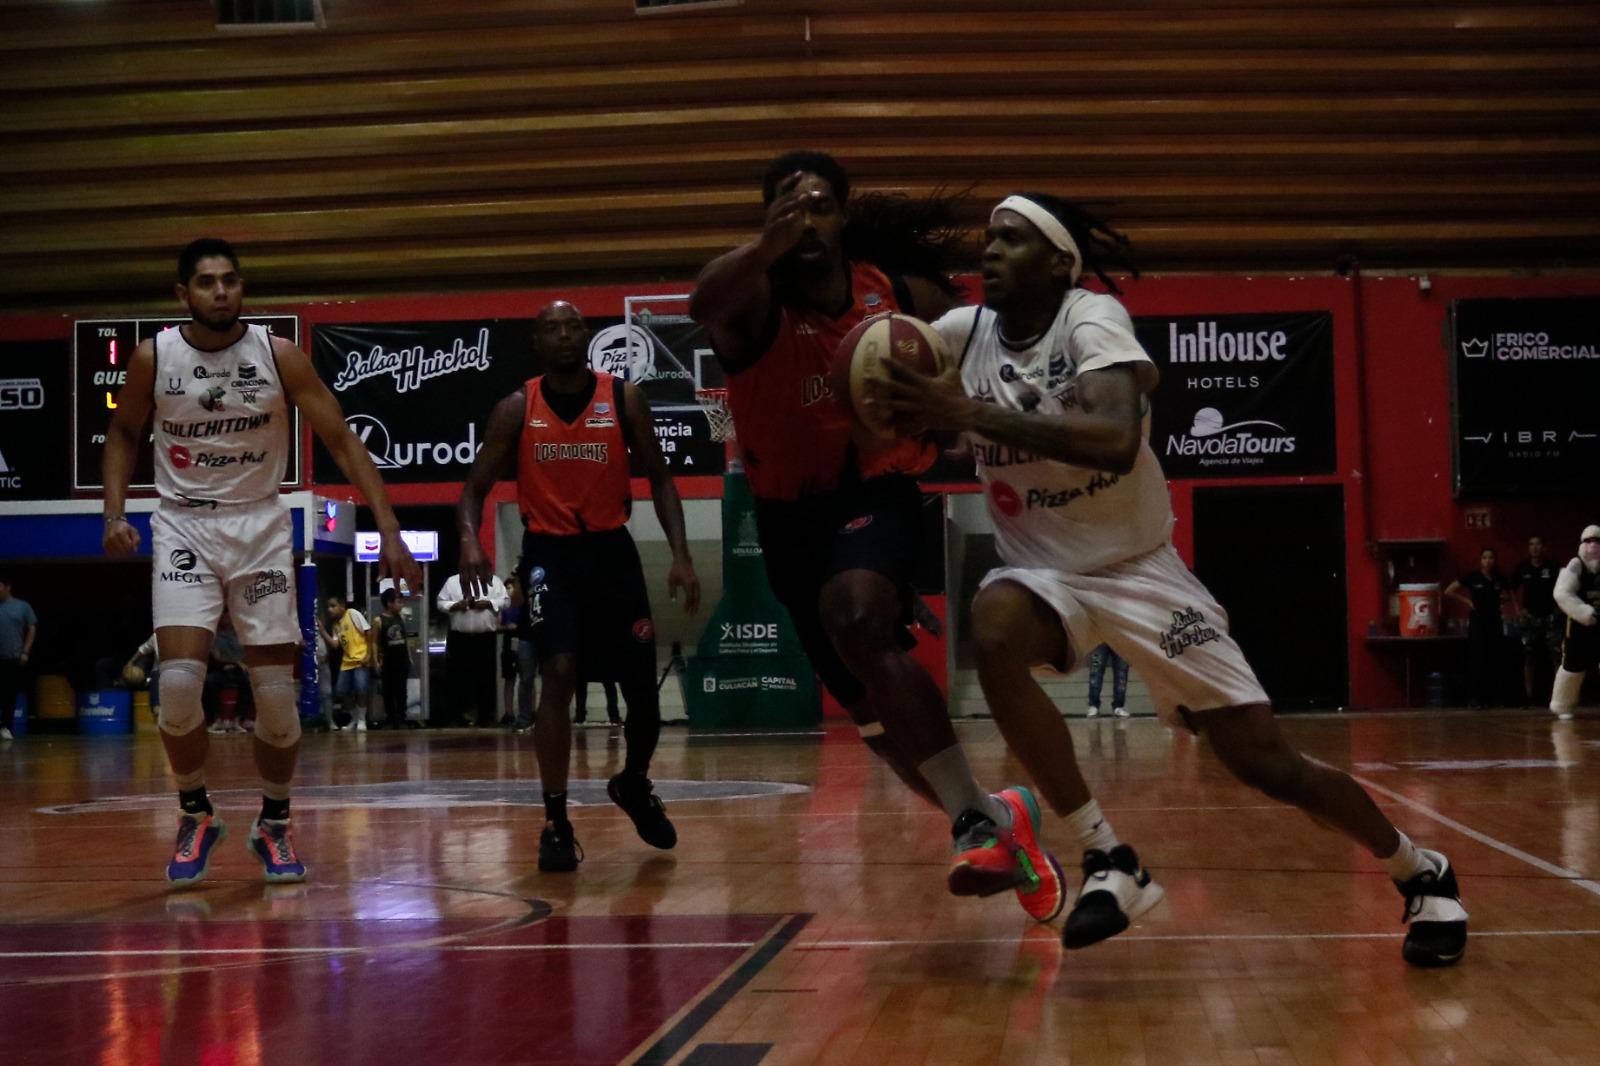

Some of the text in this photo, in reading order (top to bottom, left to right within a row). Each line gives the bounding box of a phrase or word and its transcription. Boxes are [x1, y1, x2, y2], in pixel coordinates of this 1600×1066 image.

[98, 328, 118, 337] TOL
[1495, 332, 1550, 347] FRICO
[1169, 321, 1288, 363] InHouse
[333, 327, 490, 393] Salsa Huichol
[1496, 344, 1600, 361] COMERCIAL
[1187, 376, 1261, 389] HOTELS
[161, 413, 274, 438] CULICHITOWN
[345, 414, 484, 469] Kurod
[1166, 432, 1296, 456] NavolaTours
[195, 451, 269, 468] Pizza Hut
[533, 442, 609, 465] LOS MOCHIS
[1198, 457, 1230, 467] Agencia
[1231, 457, 1241, 465] de
[1026, 486, 1084, 511] Pizza
[160, 571, 203, 583] MEGA
[736, 623, 778, 640] ISDE
